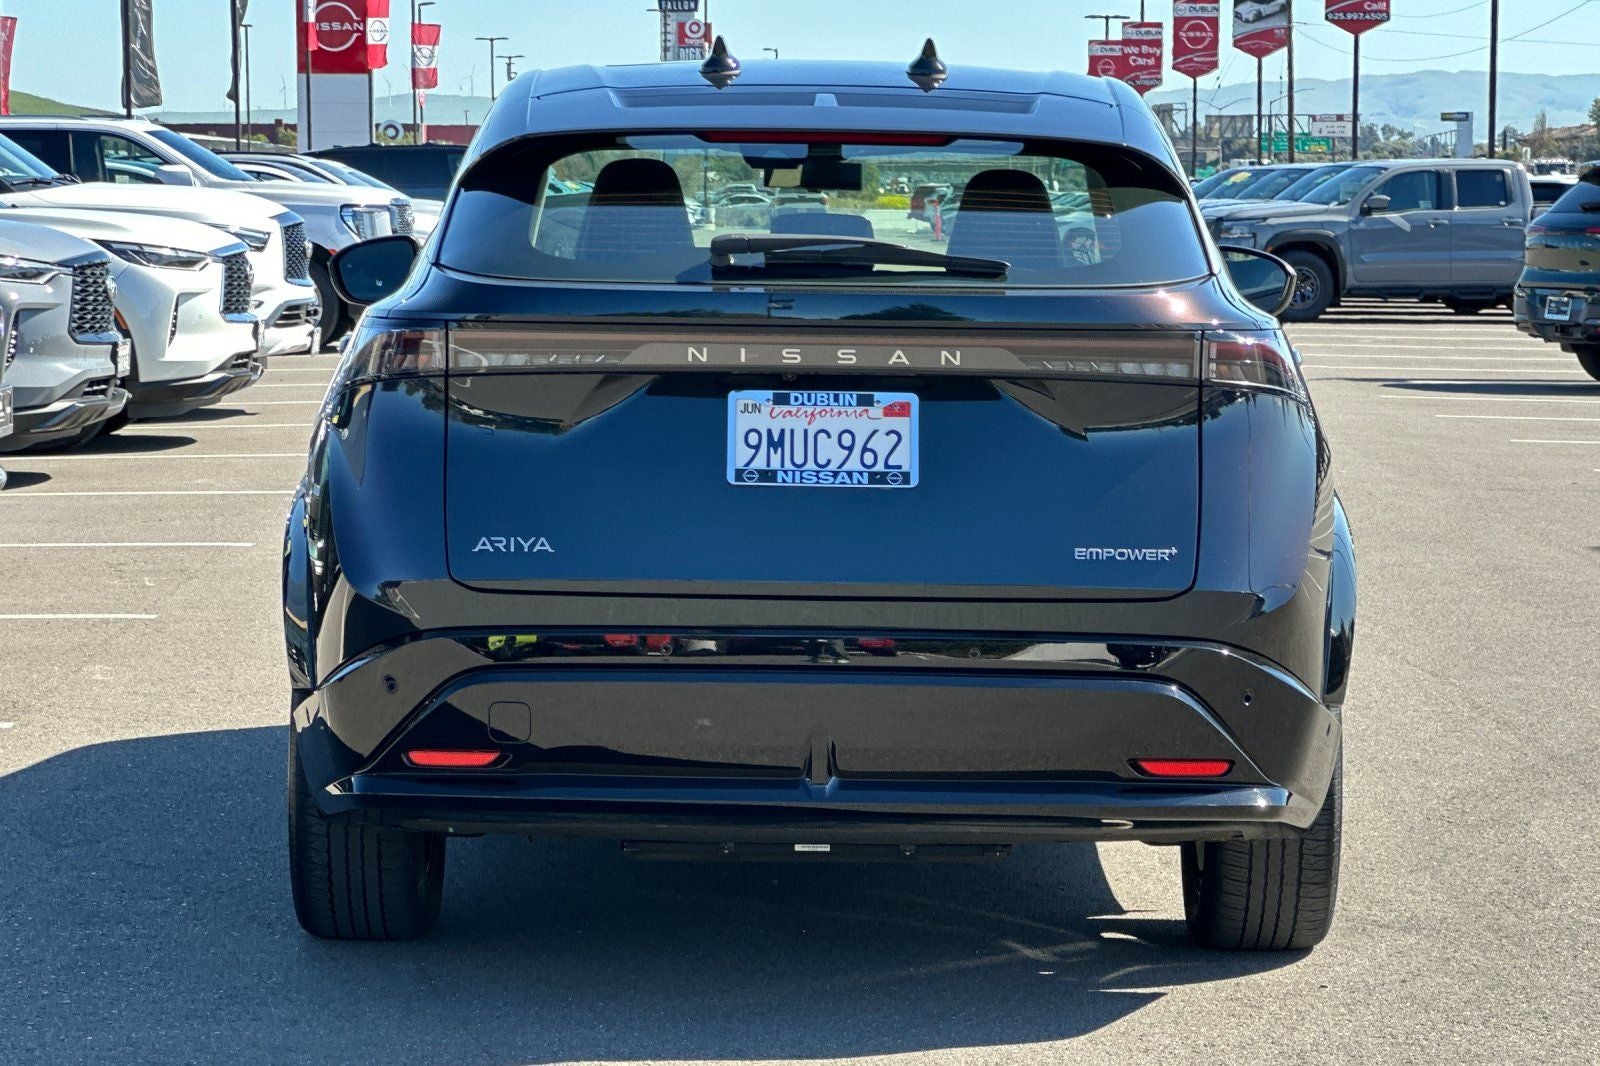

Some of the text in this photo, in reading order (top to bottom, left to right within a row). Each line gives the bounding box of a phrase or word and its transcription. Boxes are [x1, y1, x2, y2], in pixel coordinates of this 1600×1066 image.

[316, 22, 364, 31] ISSAN
[1122, 45, 1162, 56] We Buy
[687, 345, 963, 367] NISSAN
[789, 392, 857, 407] DUBLIN
[740, 402, 762, 414] JUN
[769, 406, 883, 425] California
[743, 428, 904, 470] 9MUC962
[776, 470, 869, 485] NISSAN
[471, 536, 556, 553] ARIYA
